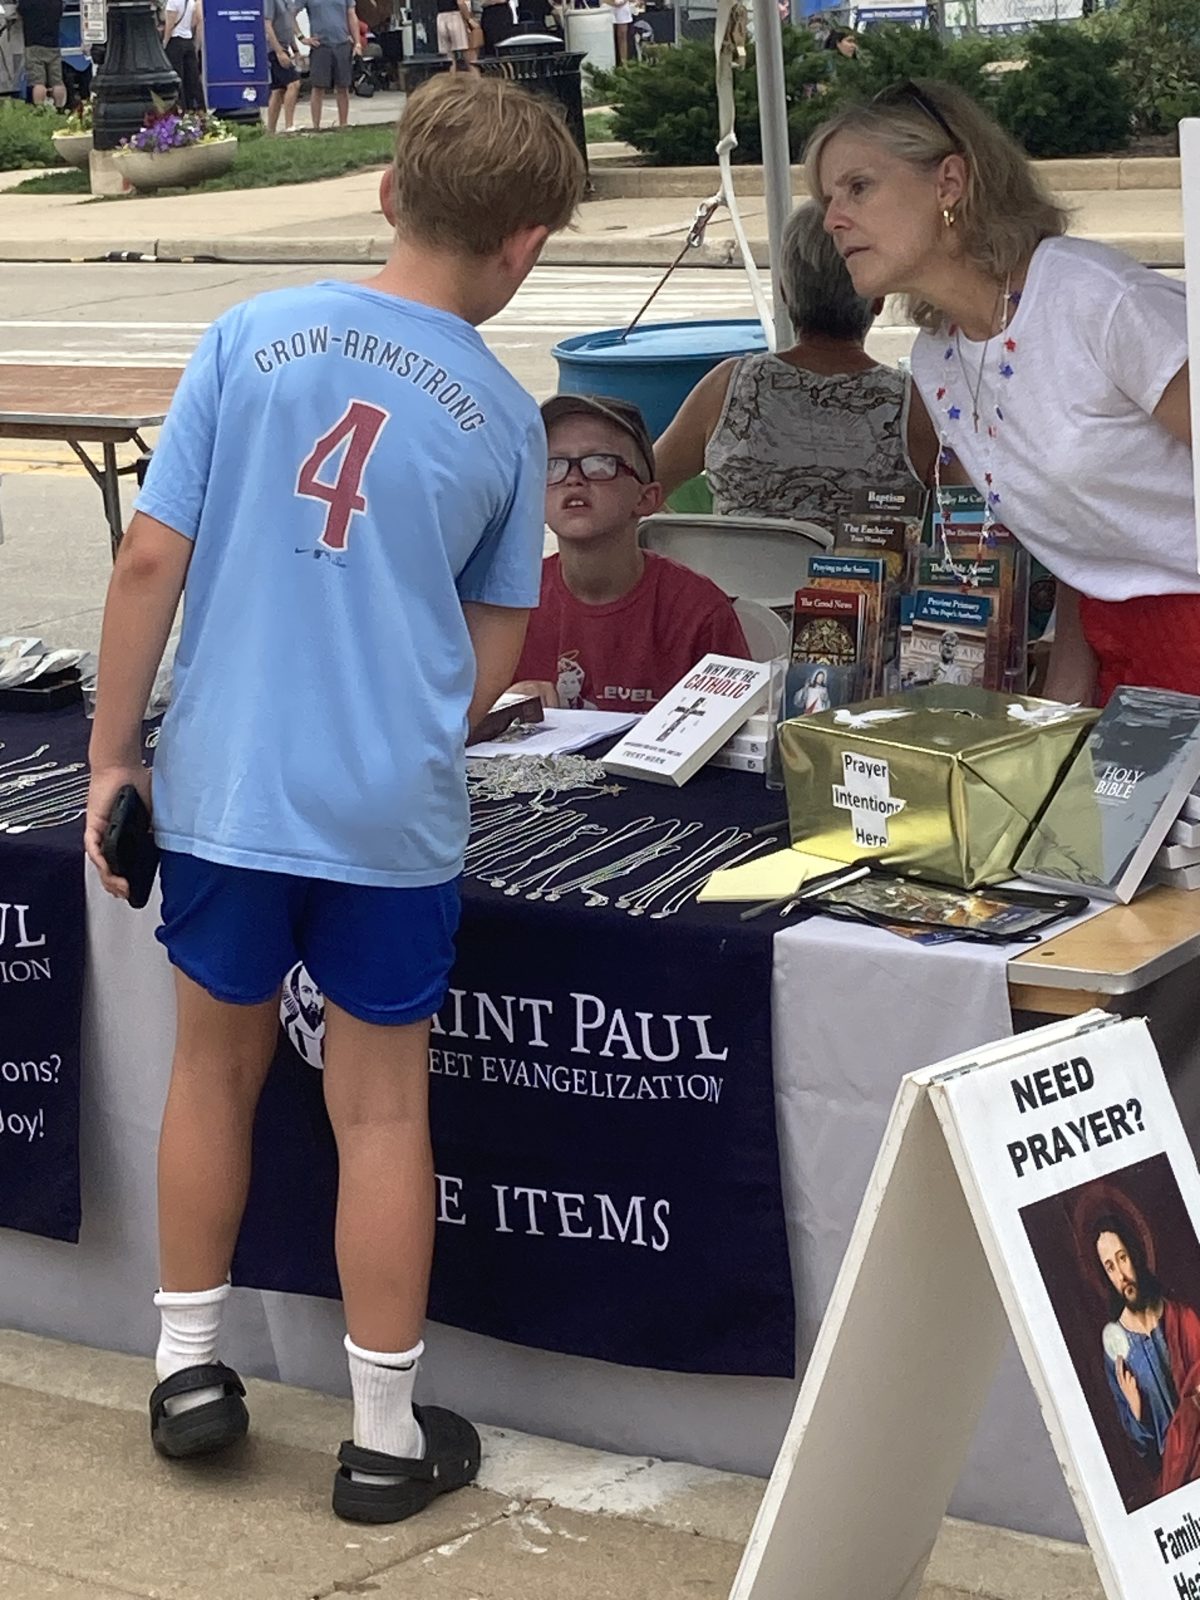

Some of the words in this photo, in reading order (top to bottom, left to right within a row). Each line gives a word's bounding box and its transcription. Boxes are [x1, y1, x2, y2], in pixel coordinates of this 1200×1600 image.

[254, 326, 487, 433] CROW-ARMSTRONG
[294, 399, 391, 551] 4
[800, 598, 812, 607] The
[814, 599, 833, 609] Good
[834, 600, 853, 610] News
[702, 662, 729, 677] WHY
[723, 666, 760, 683] WE'RE
[596, 686, 660, 703] EVEL
[683, 673, 751, 699] CATHOLIC
[844, 754, 887, 778] Prayer
[1102, 766, 1145, 785] HOLY
[1094, 780, 1136, 800] BIBLE
[855, 827, 887, 847] Here
[569, 992, 729, 1063] PAUL
[480, 1055, 724, 1104] EVANGELIZATION
[1010, 1056, 1095, 1114] NEED
[1006, 1098, 1145, 1178] PRAYER?
[491, 1183, 671, 1252] ITEMS
